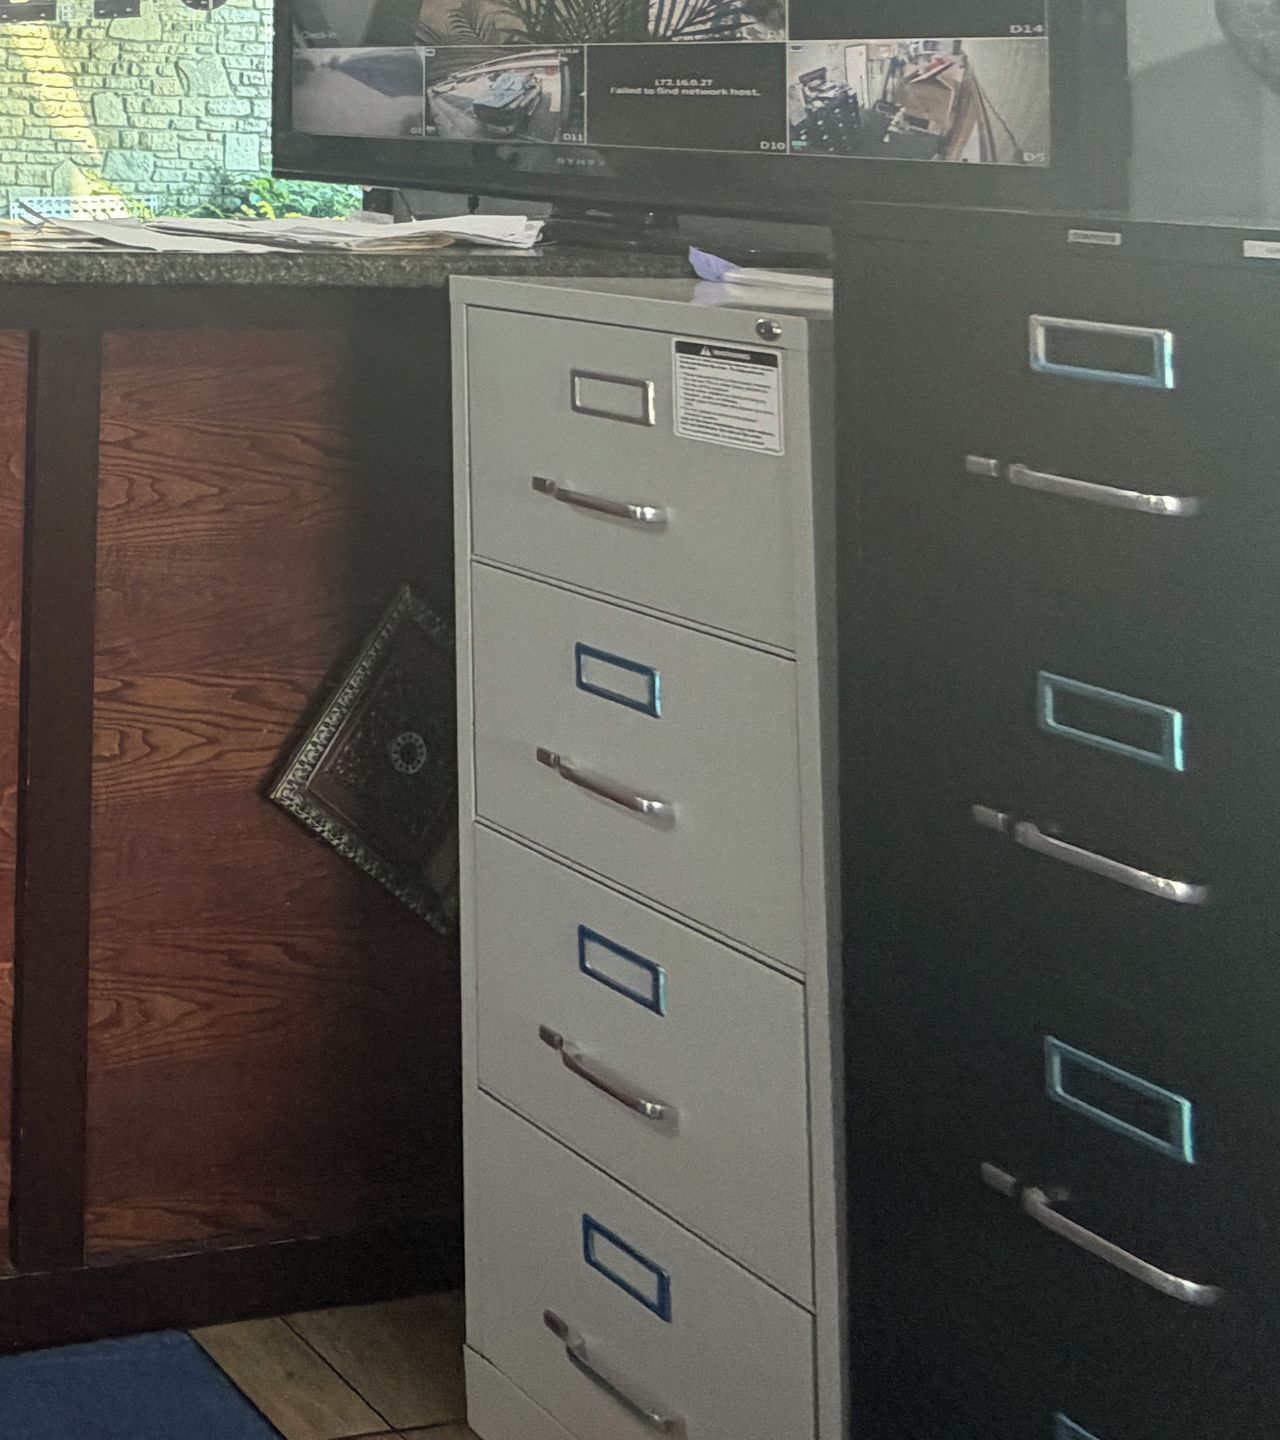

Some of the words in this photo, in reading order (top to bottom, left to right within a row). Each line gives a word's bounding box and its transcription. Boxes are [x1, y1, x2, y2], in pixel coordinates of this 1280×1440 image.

[1009, 24, 1044, 34] D14
[610, 87, 642, 95] Failed
[656, 87, 679, 95] find
[681, 88, 728, 96] network
[730, 88, 761, 97] host.
[760, 141, 786, 150] D10
